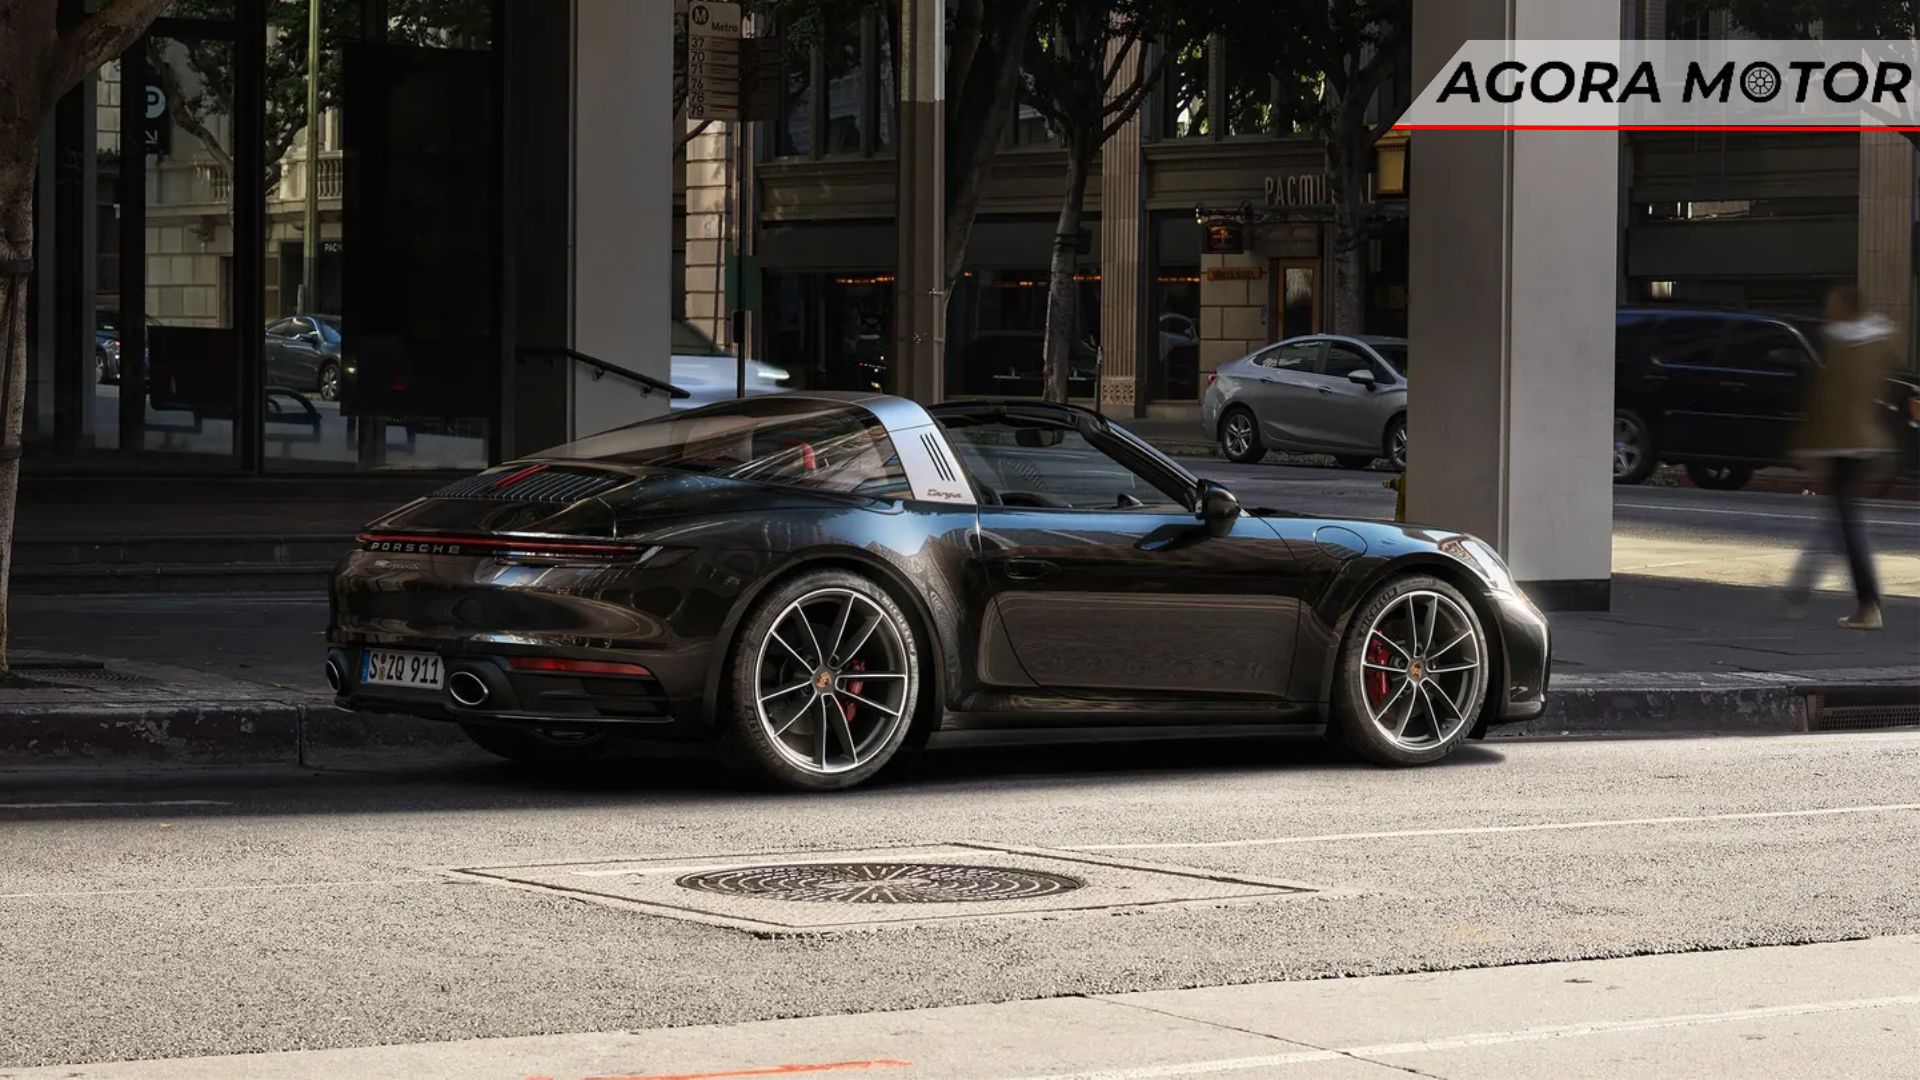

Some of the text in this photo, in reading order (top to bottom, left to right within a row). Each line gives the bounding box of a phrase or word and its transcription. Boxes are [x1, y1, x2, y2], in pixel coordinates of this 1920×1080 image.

[711, 22, 738, 33] Metro
[691, 51, 705, 62] 70
[691, 64, 703, 75] 71
[691, 78, 704, 89] 76
[691, 91, 705, 103] 78
[691, 105, 705, 116] 79
[1265, 172, 1376, 206] PACMUL
[927, 488, 962, 499] Targa
[371, 542, 461, 554] PORSCHE
[369, 654, 379, 679] S
[411, 656, 439, 684] 911
